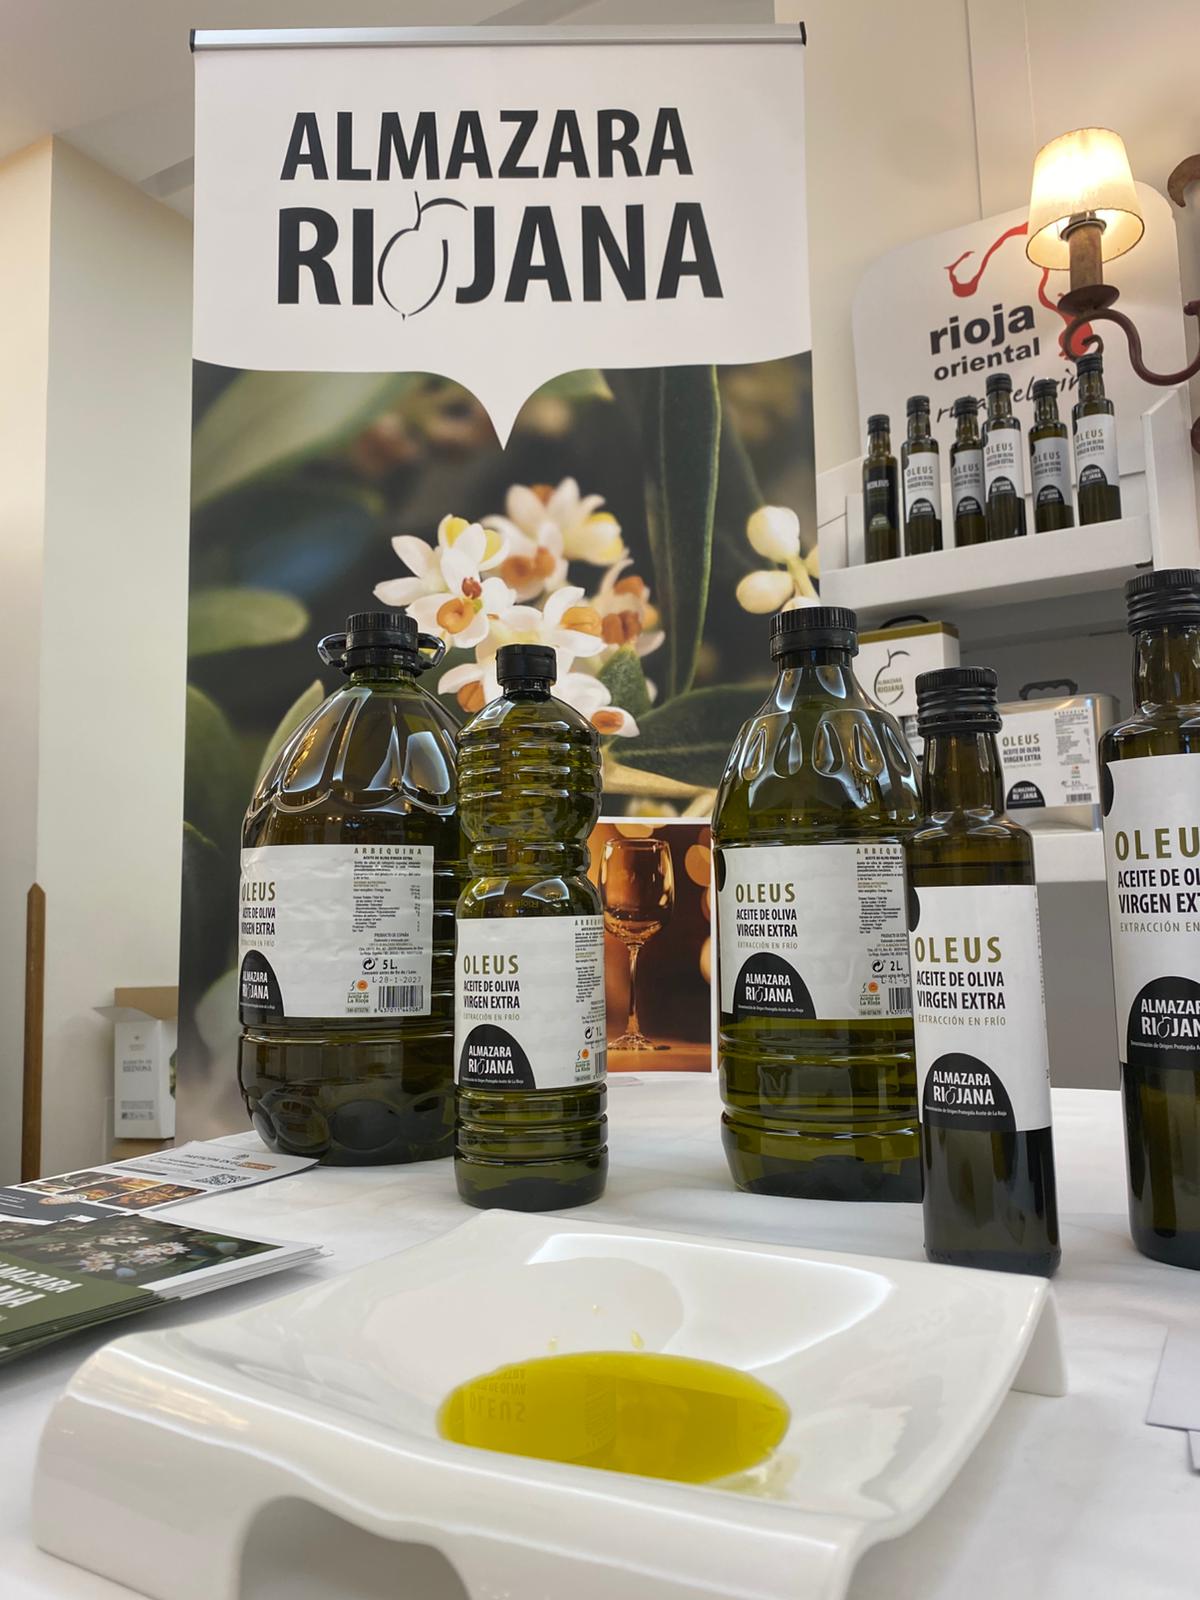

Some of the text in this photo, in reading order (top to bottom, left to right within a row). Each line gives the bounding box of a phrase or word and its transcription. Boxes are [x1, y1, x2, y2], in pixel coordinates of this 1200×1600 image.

[280, 107, 694, 181] ALMAZARA
[277, 192, 724, 320] RIOJANA
[929, 304, 1035, 355] rioja
[934, 337, 1040, 380] oriental
[1076, 429, 1103, 443] OLEUS
[986, 443, 1013, 455] OLEUS
[1033, 451, 1061, 464] OLEUS
[907, 466, 933, 477] OLEUS
[953, 463, 979, 476] OLEUS
[1002, 733, 1040, 747] OLEUS
[1003, 754, 1041, 763] VIRGEN EXTRA
[354, 847, 422, 855] ARBEQUINA
[1118, 869, 1157, 889] ACEITE
[1161, 868, 1179, 886] DE
[241, 882, 276, 901] OLEUS
[736, 883, 796, 903] OLEUS
[1118, 893, 1171, 914] VIRGEN
[252, 907, 259, 918] DE
[259, 907, 276, 919] OLIVA
[736, 909, 797, 921] ACEITE DE OLIVA
[255, 922, 275, 936] EXTRA
[737, 925, 798, 937] VIRGEN EXTRA
[1120, 920, 1180, 933] EXTRACCIÓN
[738, 940, 798, 950] EXTRACCIÓN EN FRÍO
[915, 936, 1002, 964] OLEUS
[464, 955, 519, 975] OLEUS
[464, 980, 520, 992] ACEITE DE OLIVA
[745, 973, 791, 986] ALMAZARA
[916, 971, 946, 987] ACEITE
[949, 971, 964, 987] DE
[967, 971, 1005, 987] OLIVA
[745, 986, 794, 1004] RIOJANA
[917, 990, 1006, 1010] VIRGEN EXTRA
[464, 996, 520, 1009] VIRGEN EXTRA
[494, 1013, 501, 1021] EN
[502, 1013, 520, 1021] FRÍO
[918, 1013, 1007, 1026] EXTRACCIÓN EN FRÍO
[468, 1045, 512, 1058] ALMAZARA
[468, 1058, 514, 1075] RIOJANA
[933, 1070, 991, 1086] ALMAZARA
[933, 1085, 995, 1105] RIOJANA
